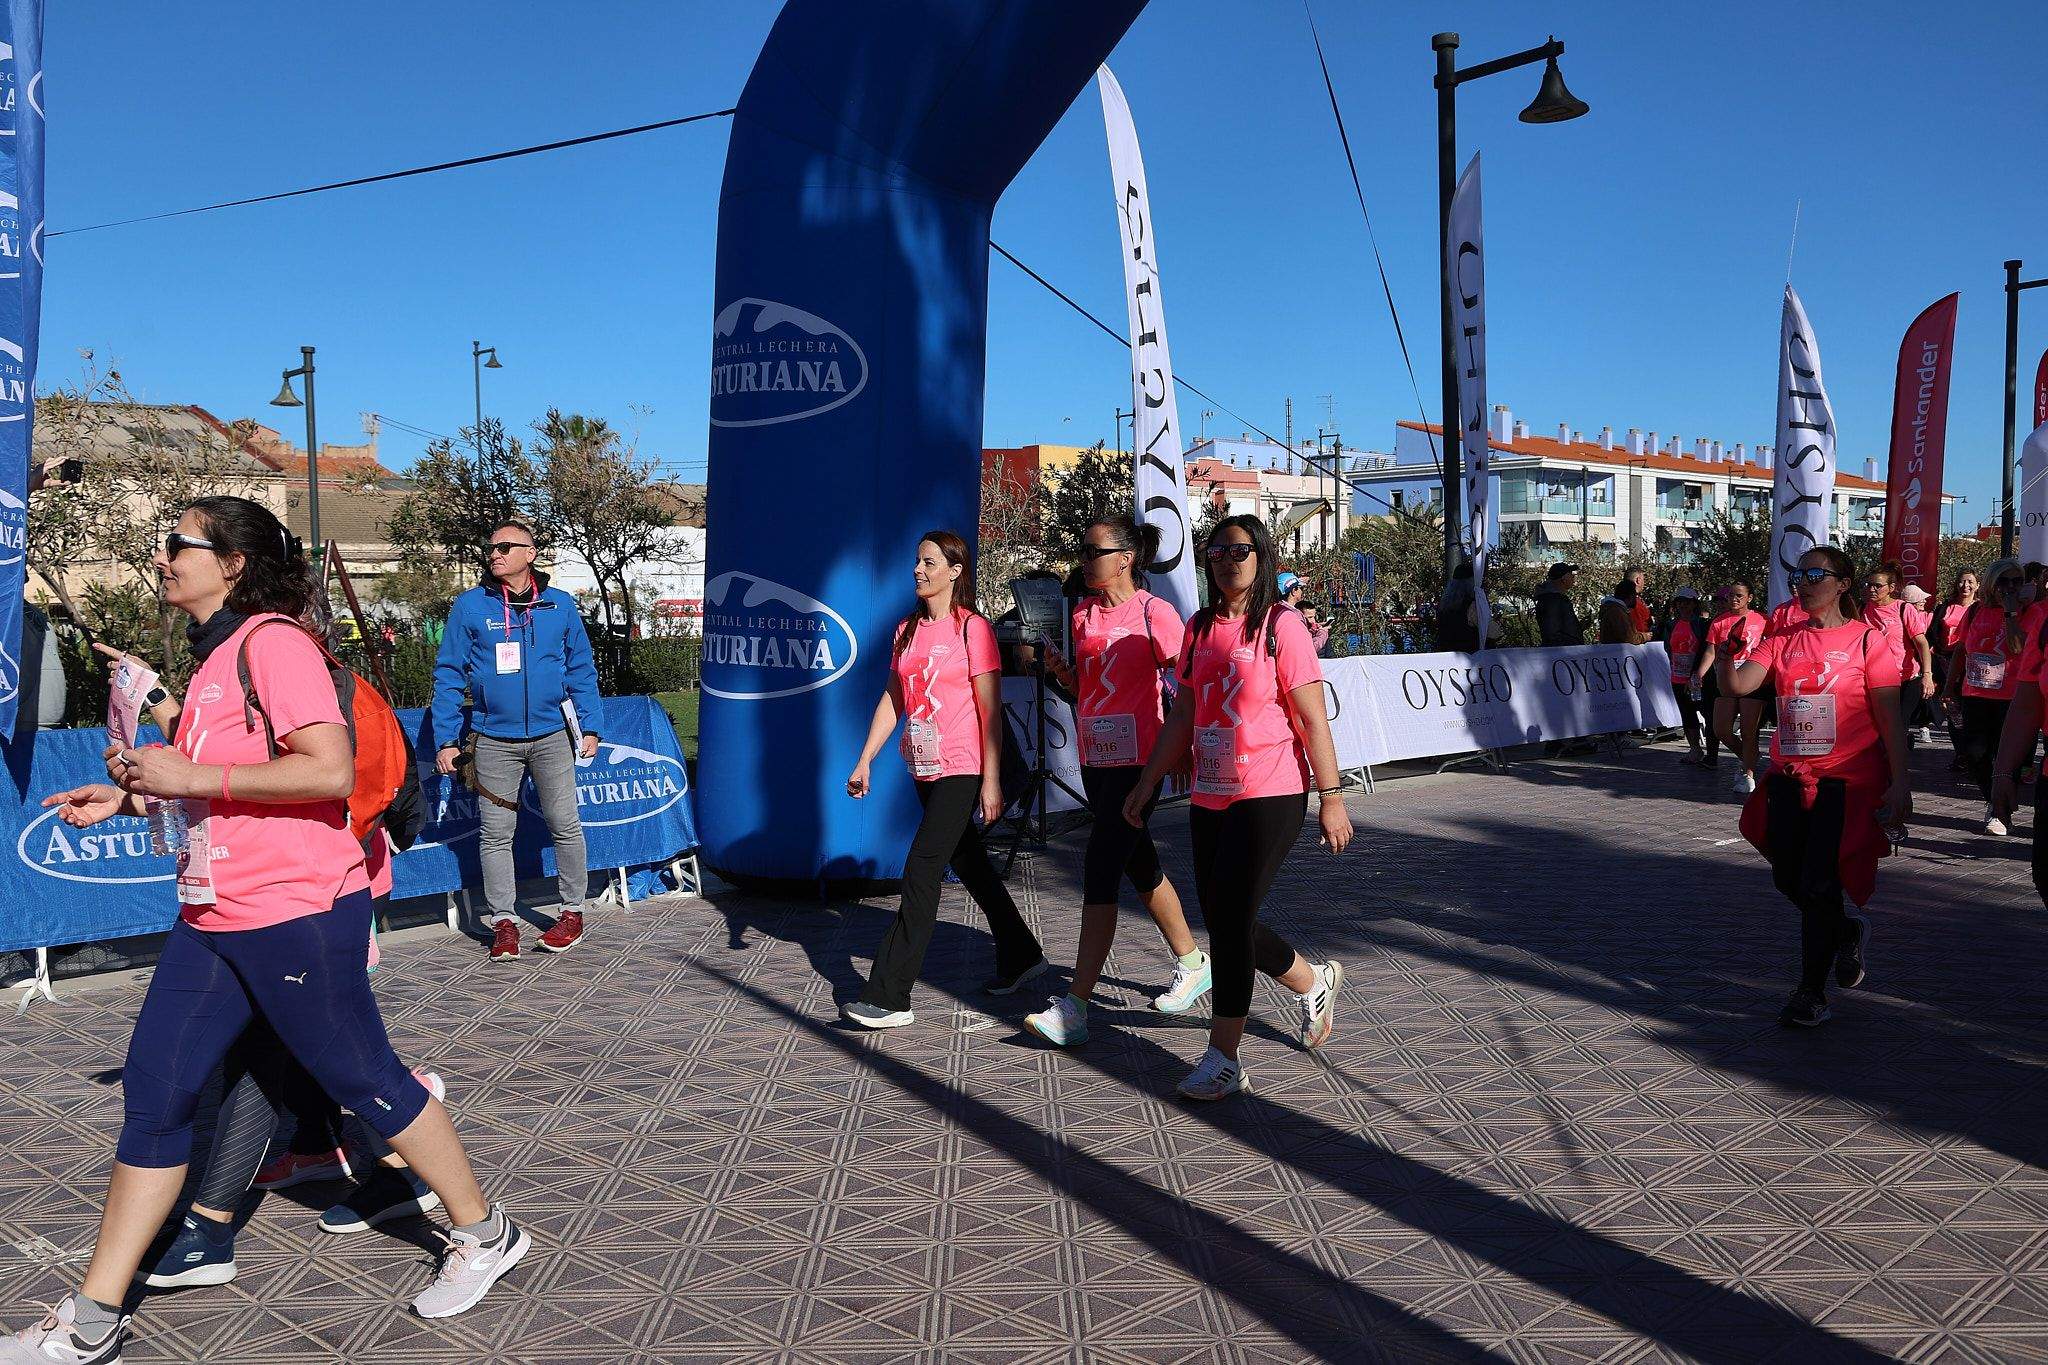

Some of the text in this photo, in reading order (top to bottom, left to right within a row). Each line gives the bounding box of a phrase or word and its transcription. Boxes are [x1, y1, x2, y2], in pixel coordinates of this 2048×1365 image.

[759, 340, 839, 353] LECHERA
[1908, 340, 1939, 473] Santander
[1901, 513, 1924, 587] ports
[749, 616, 828, 632] LECHERA
[1402, 663, 1513, 711] OYSHO
[1552, 654, 1644, 697] OYSHO
[616, 765, 668, 779] LECHERA
